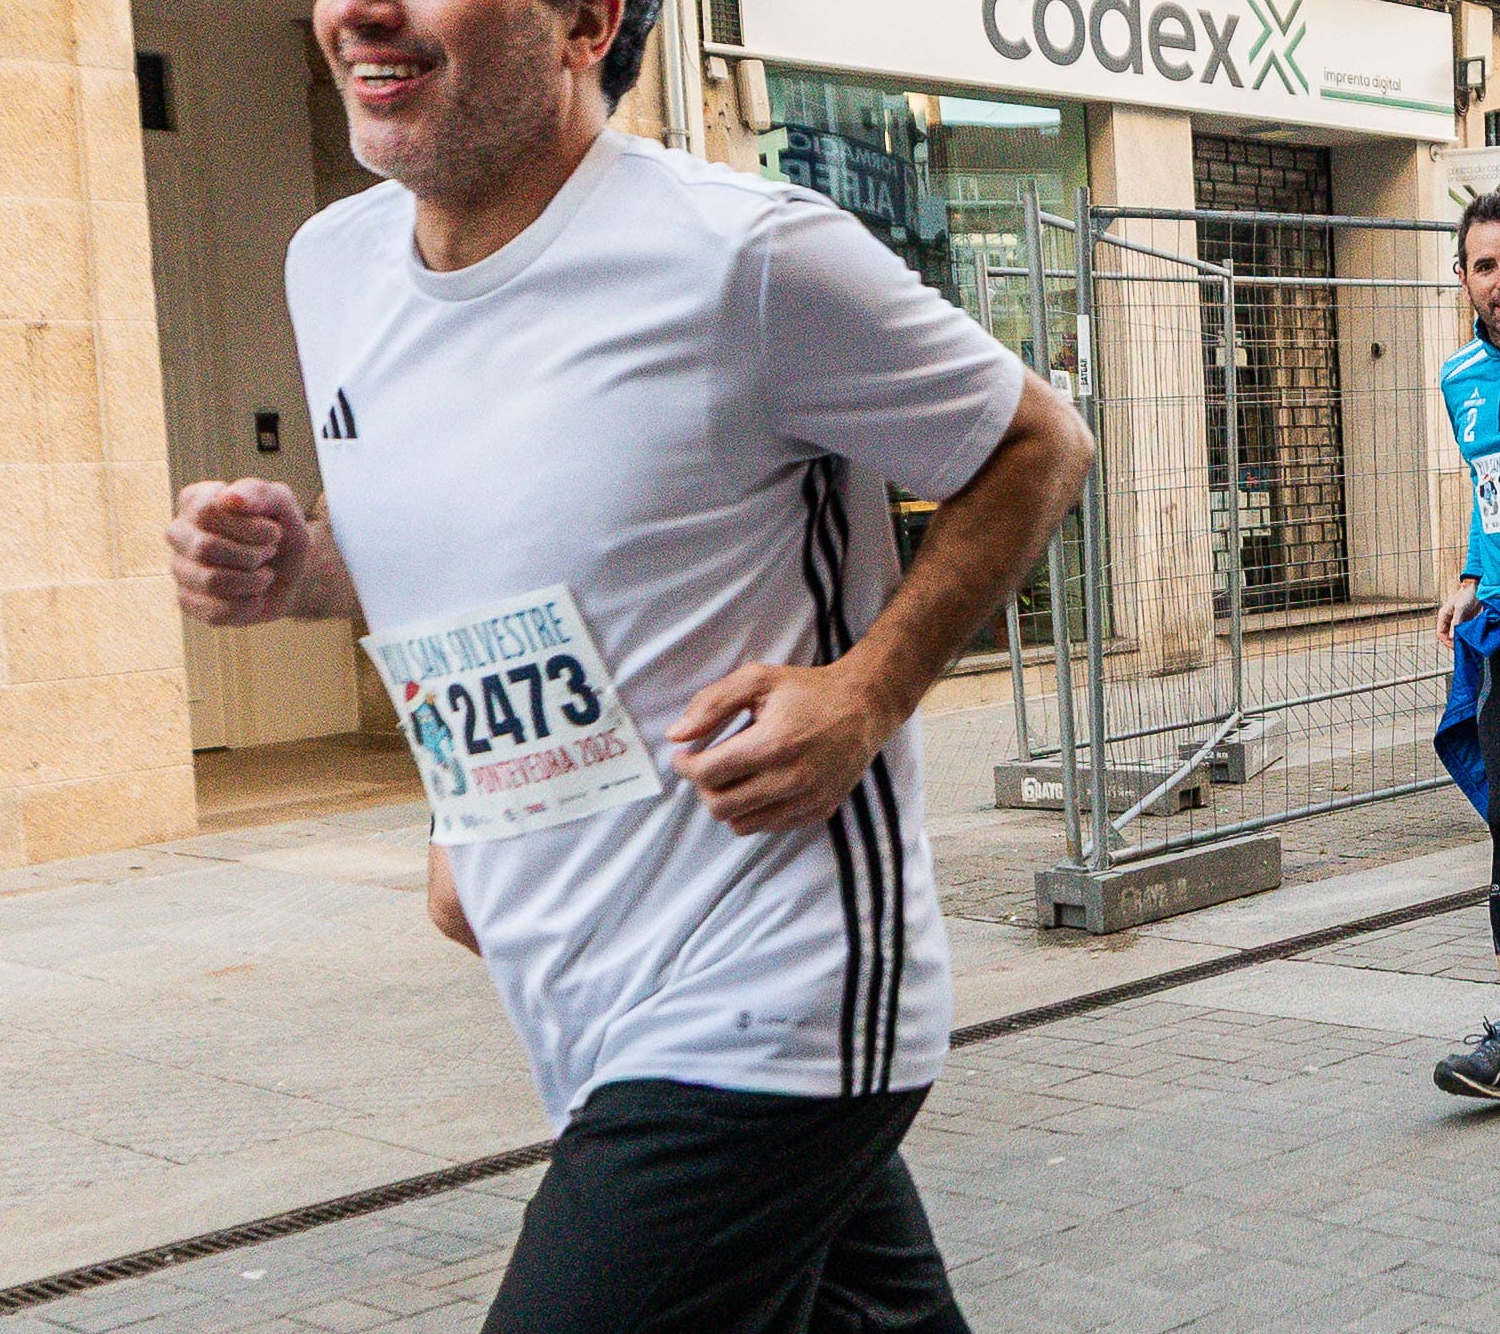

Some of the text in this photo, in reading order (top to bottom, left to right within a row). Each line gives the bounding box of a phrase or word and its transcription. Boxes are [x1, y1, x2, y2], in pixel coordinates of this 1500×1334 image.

[1323, 66, 1402, 95] imprenta digital
[1463, 408, 1478, 442] 2
[449, 601, 572, 672] SILVESTRE
[447, 653, 601, 755] 2473
[574, 727, 629, 768] 2025
